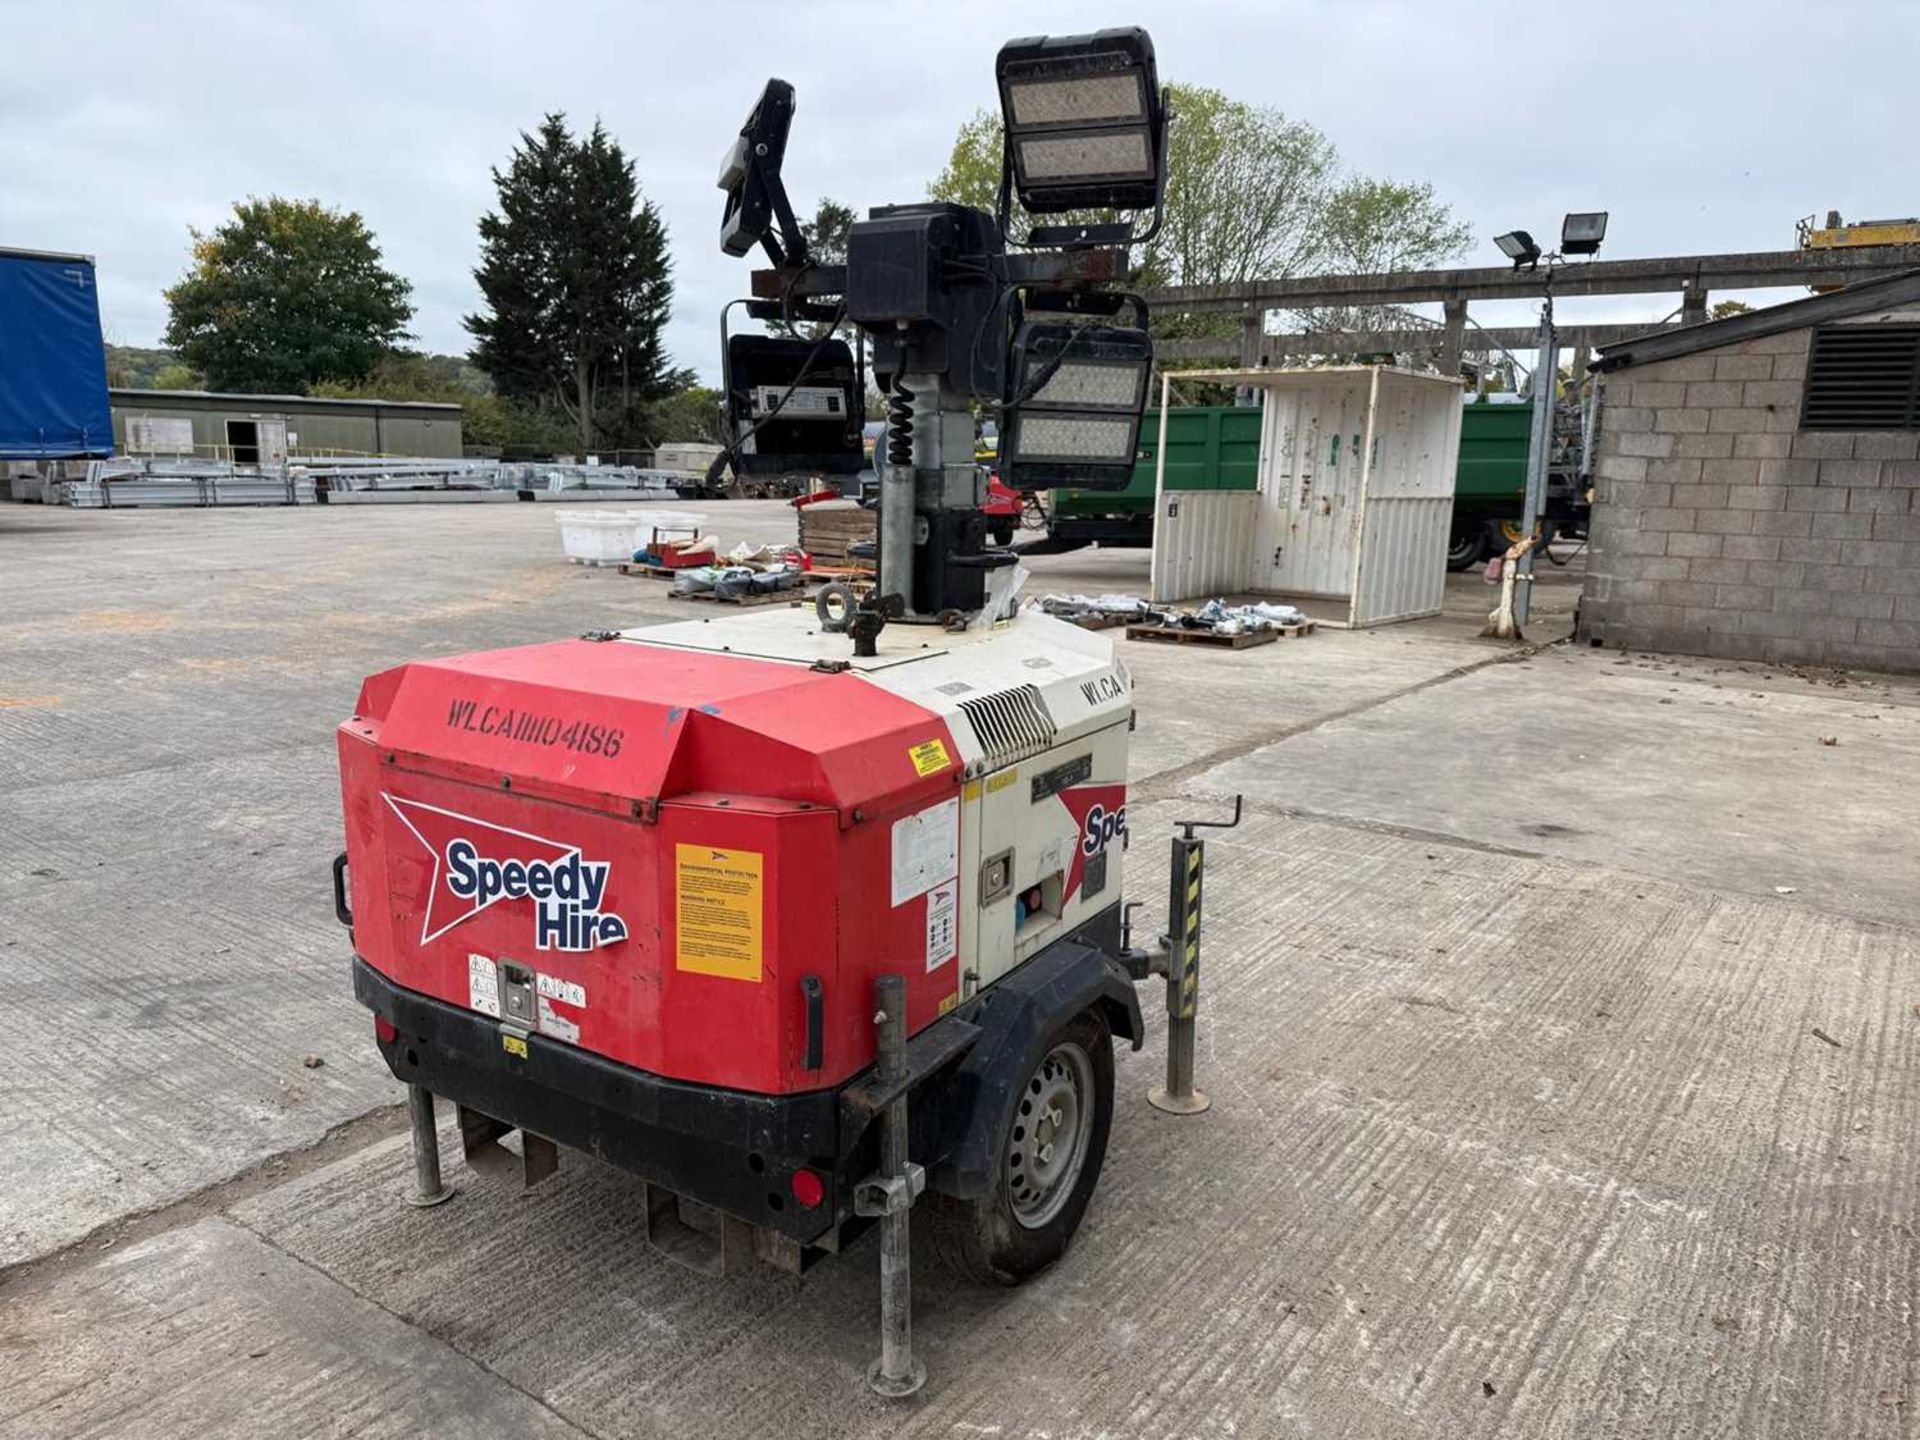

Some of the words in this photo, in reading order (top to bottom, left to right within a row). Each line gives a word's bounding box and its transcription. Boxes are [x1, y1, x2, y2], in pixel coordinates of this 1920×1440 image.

[1080, 675, 1124, 706] WLCA
[448, 841, 608, 911] Speedy
[538, 902, 626, 949] Hire
